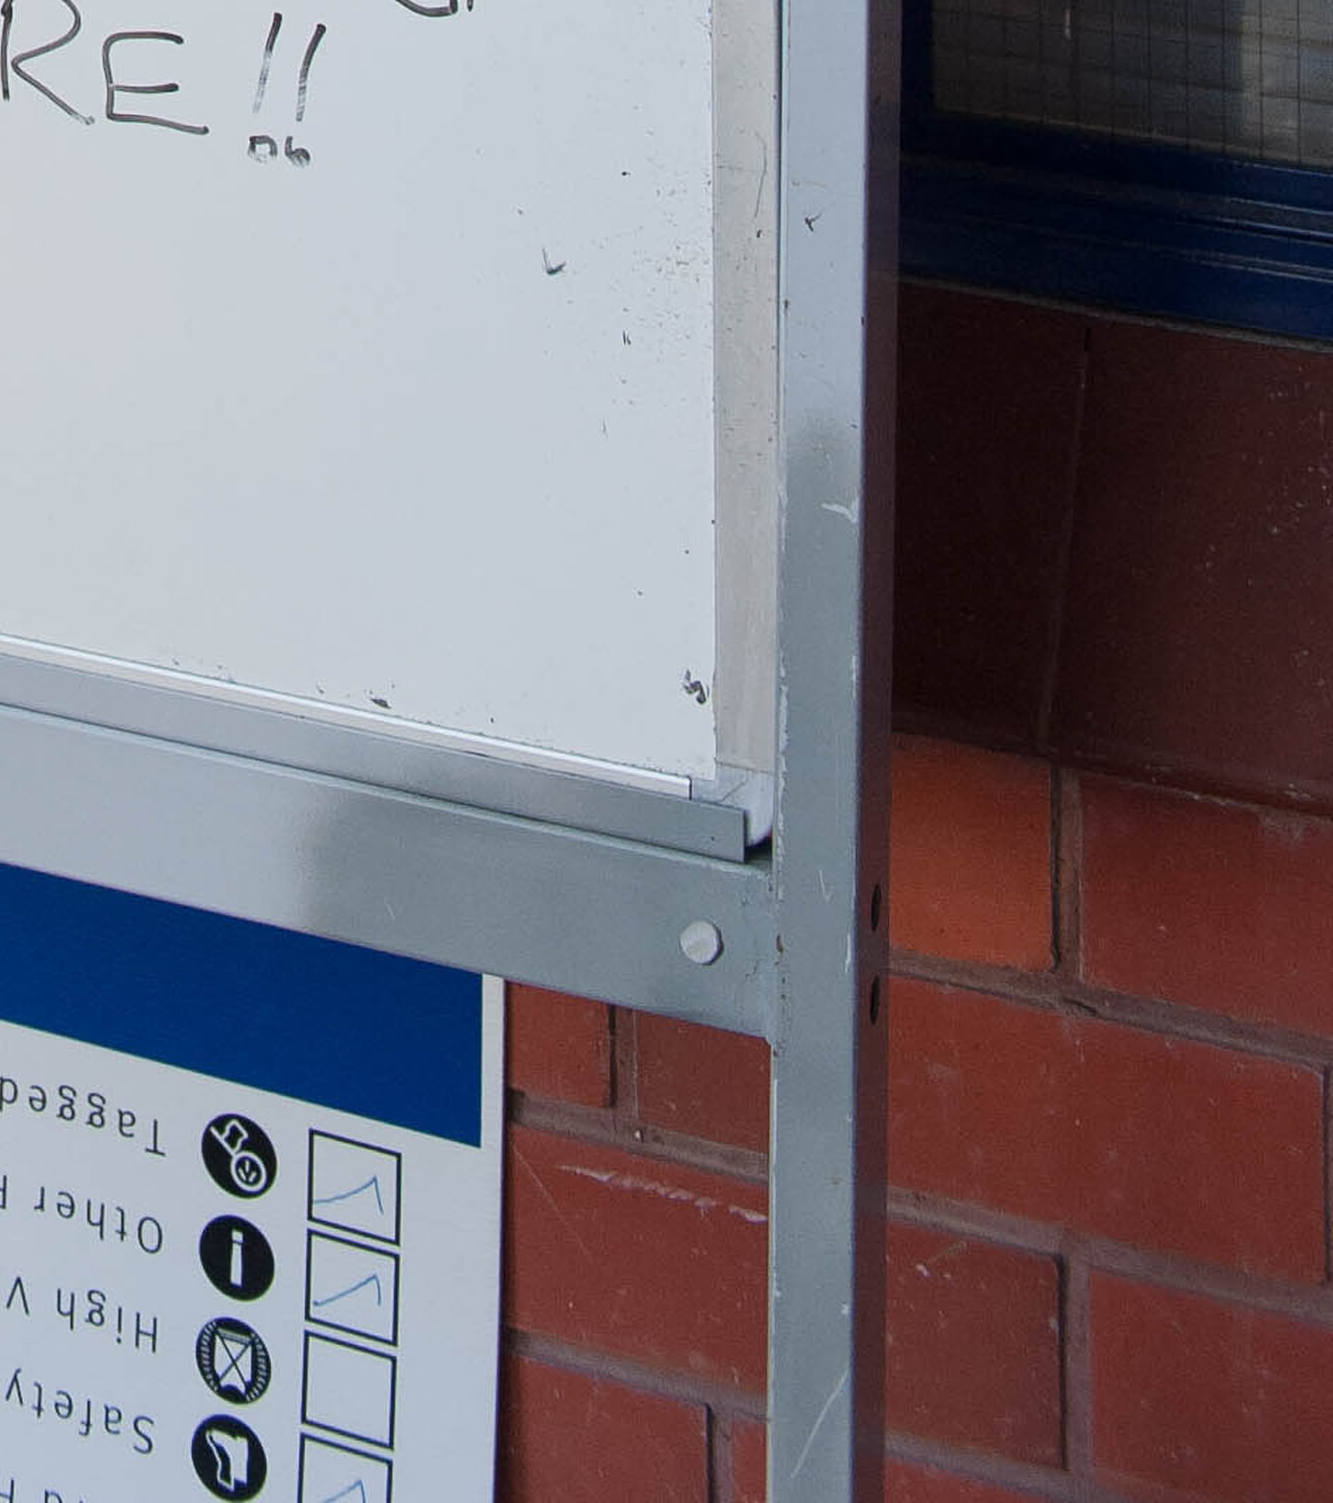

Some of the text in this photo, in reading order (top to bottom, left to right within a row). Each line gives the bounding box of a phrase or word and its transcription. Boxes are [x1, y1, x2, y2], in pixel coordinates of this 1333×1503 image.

[32, 1185, 164, 1255] Other
[56, 1287, 159, 1354] High
[4, 1367, 156, 1455] Safety
